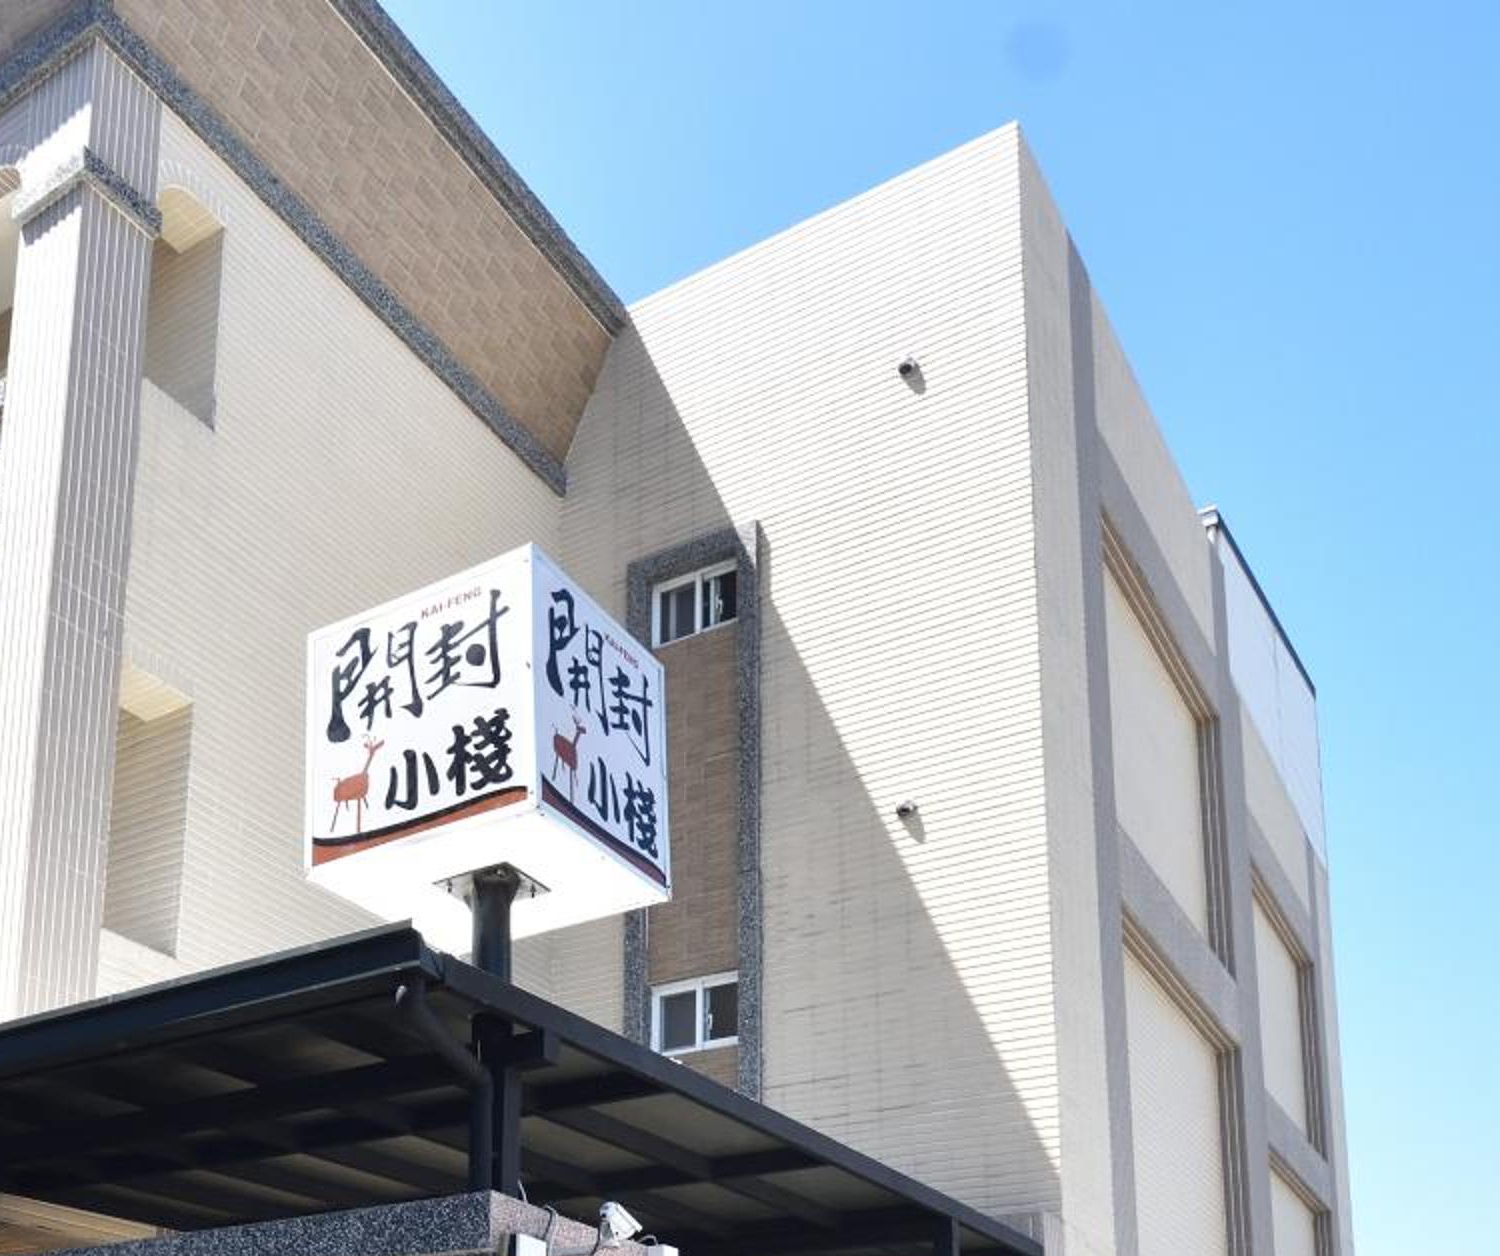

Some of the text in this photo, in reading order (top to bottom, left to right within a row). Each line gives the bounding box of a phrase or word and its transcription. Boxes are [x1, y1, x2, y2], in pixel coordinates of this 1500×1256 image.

[327, 588, 509, 742] 開封
[545, 588, 652, 766] 開封
[385, 708, 513, 811] 小棧
[588, 757, 658, 859] 小棧
